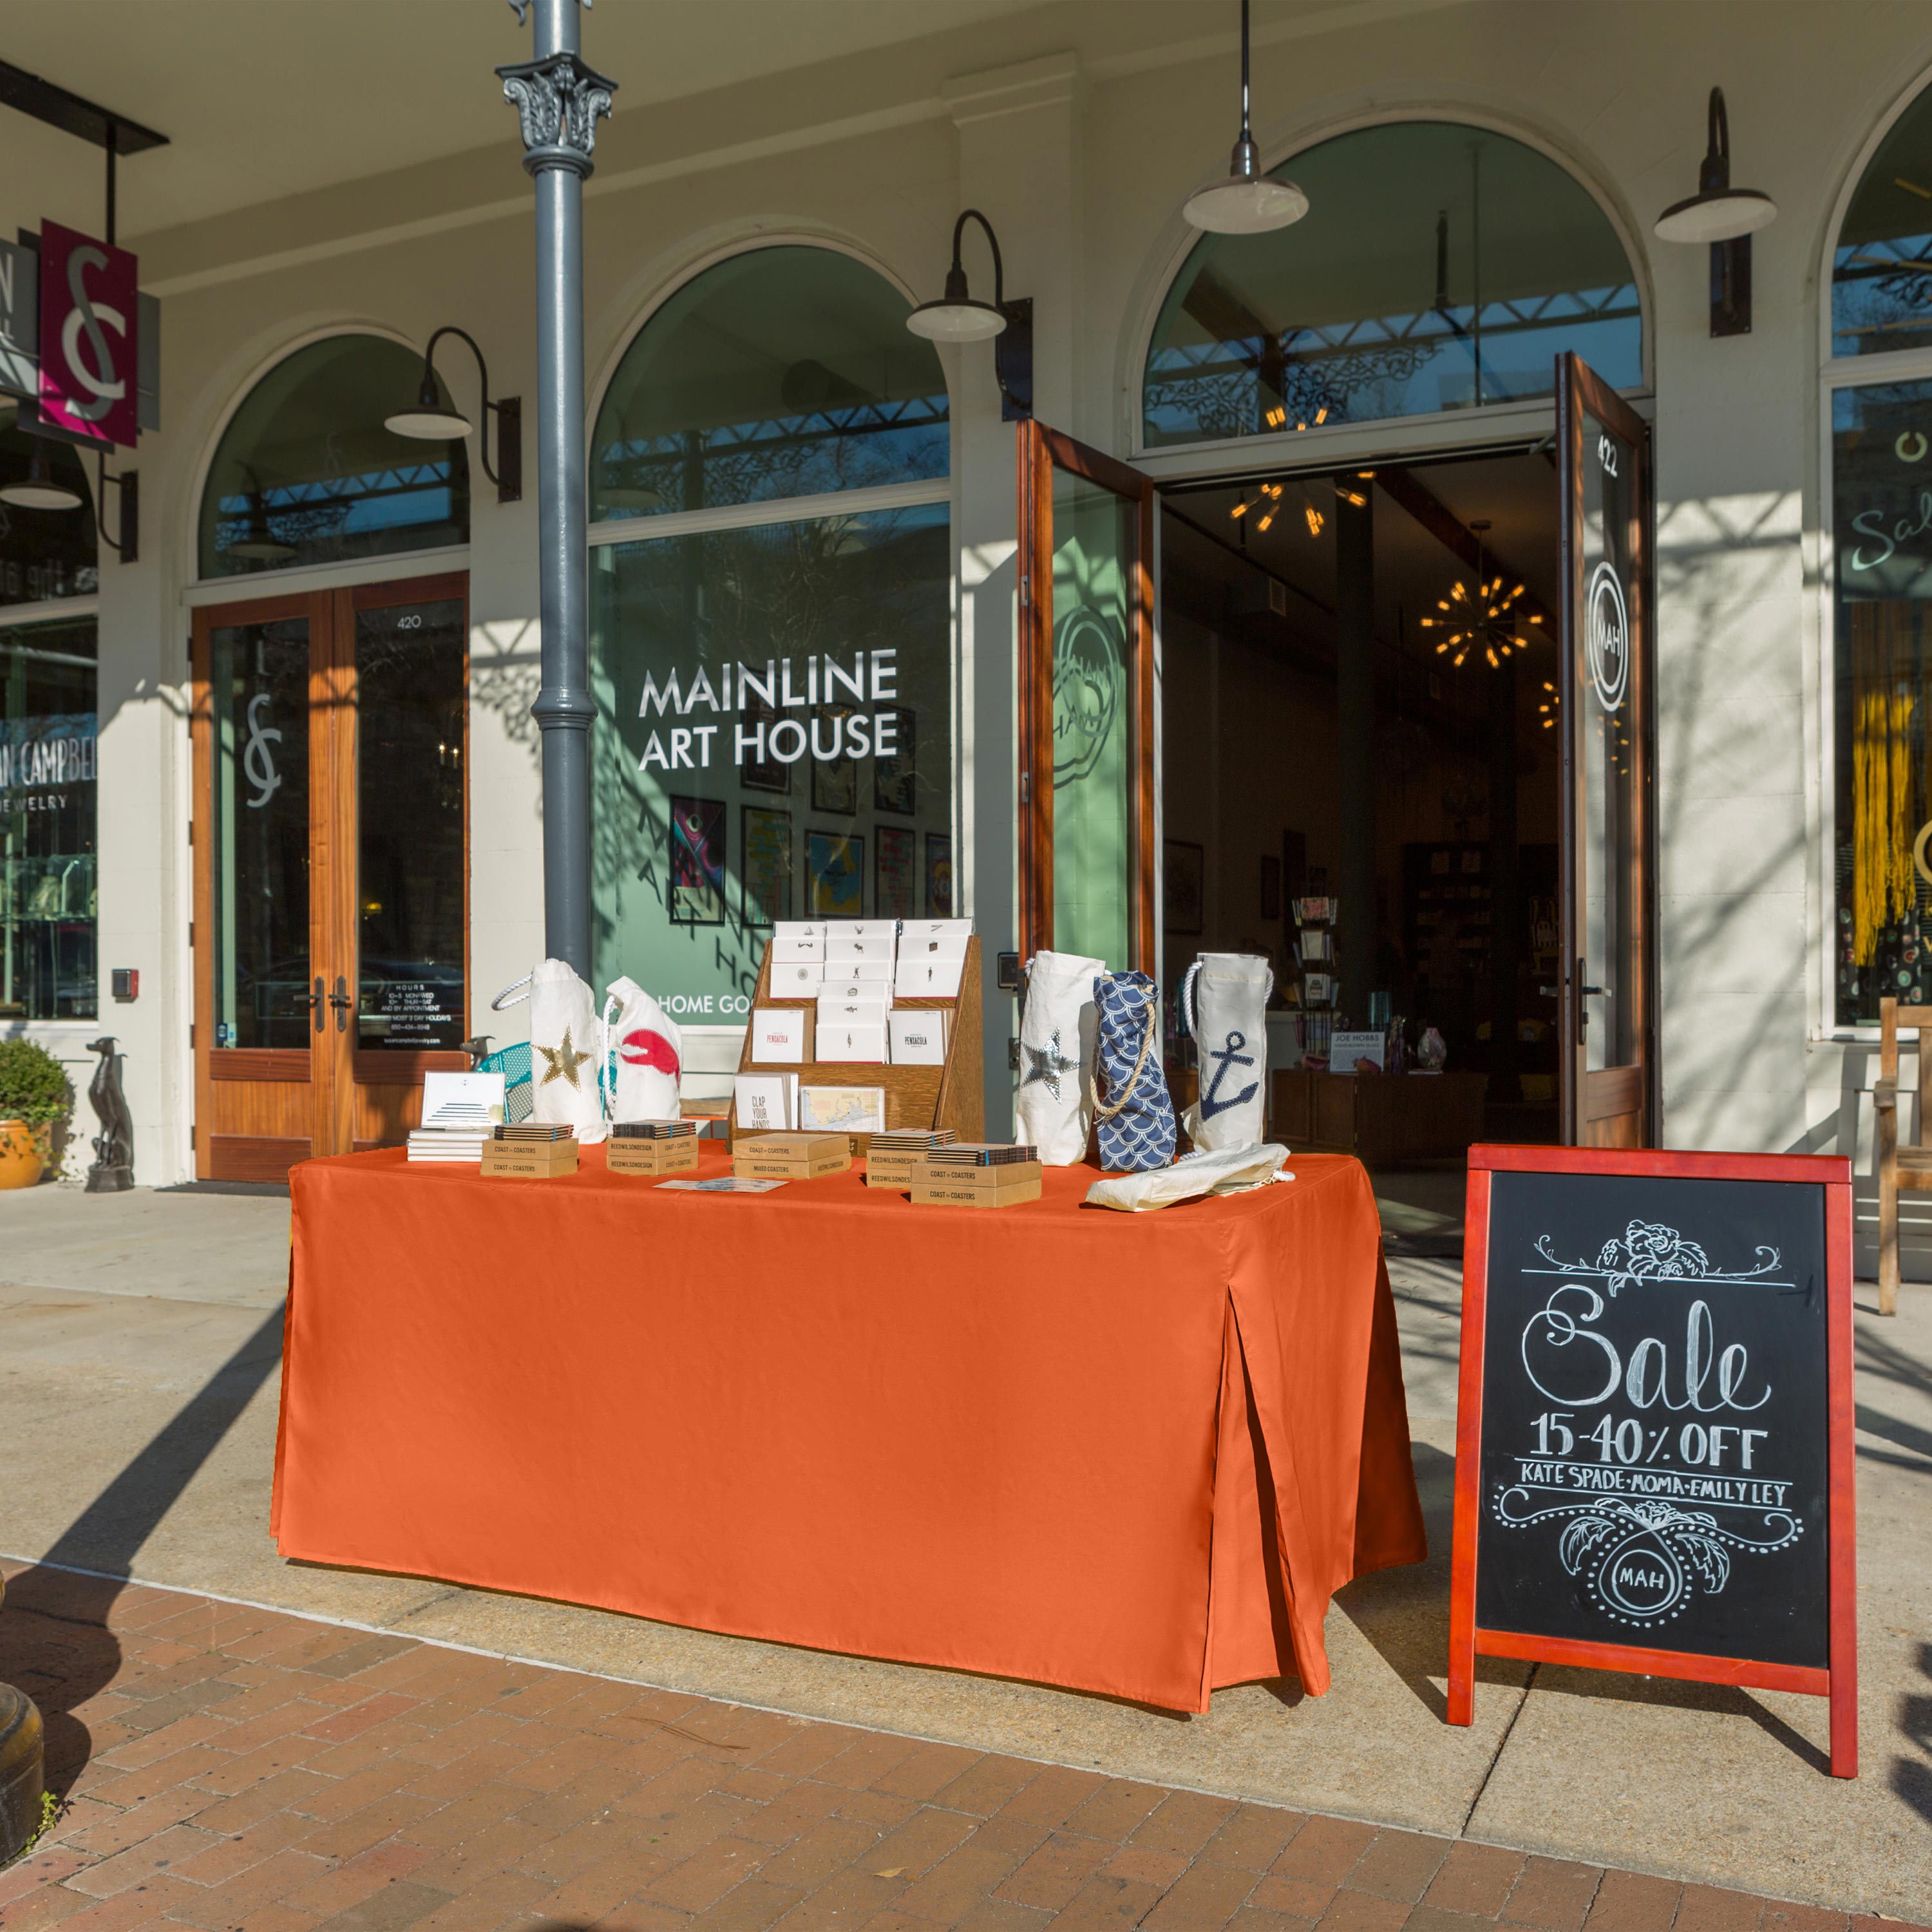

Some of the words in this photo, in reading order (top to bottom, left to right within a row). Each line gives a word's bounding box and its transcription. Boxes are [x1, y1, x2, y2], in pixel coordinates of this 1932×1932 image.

[1598, 434, 1618, 478] 422
[397, 615, 422, 630] 420
[1596, 616, 1621, 658] MAH
[638, 649, 897, 717] MAINLINE
[638, 726, 717, 771] ART
[734, 713, 898, 764] HOUSE
[0, 795, 68, 813] EWELRY
[658, 995, 713, 1014] HOME
[719, 995, 754, 1014] GO
[767, 1034, 788, 1043] PENSACOLA
[905, 1036, 927, 1045] PENSACOLA
[752, 1096, 765, 1107] CLAP
[752, 1108, 767, 1119] YOUR
[752, 1119, 770, 1129] HANDS
[1522, 1284, 1771, 1412] Sale
[1530, 1413, 1670, 1464] 15-40%
[1679, 1423, 1768, 1470] OFF
[1521, 1463, 1564, 1483] KATE
[1752, 1482, 1786, 1506] LEY
[1620, 1567, 1665, 1589] MAH
